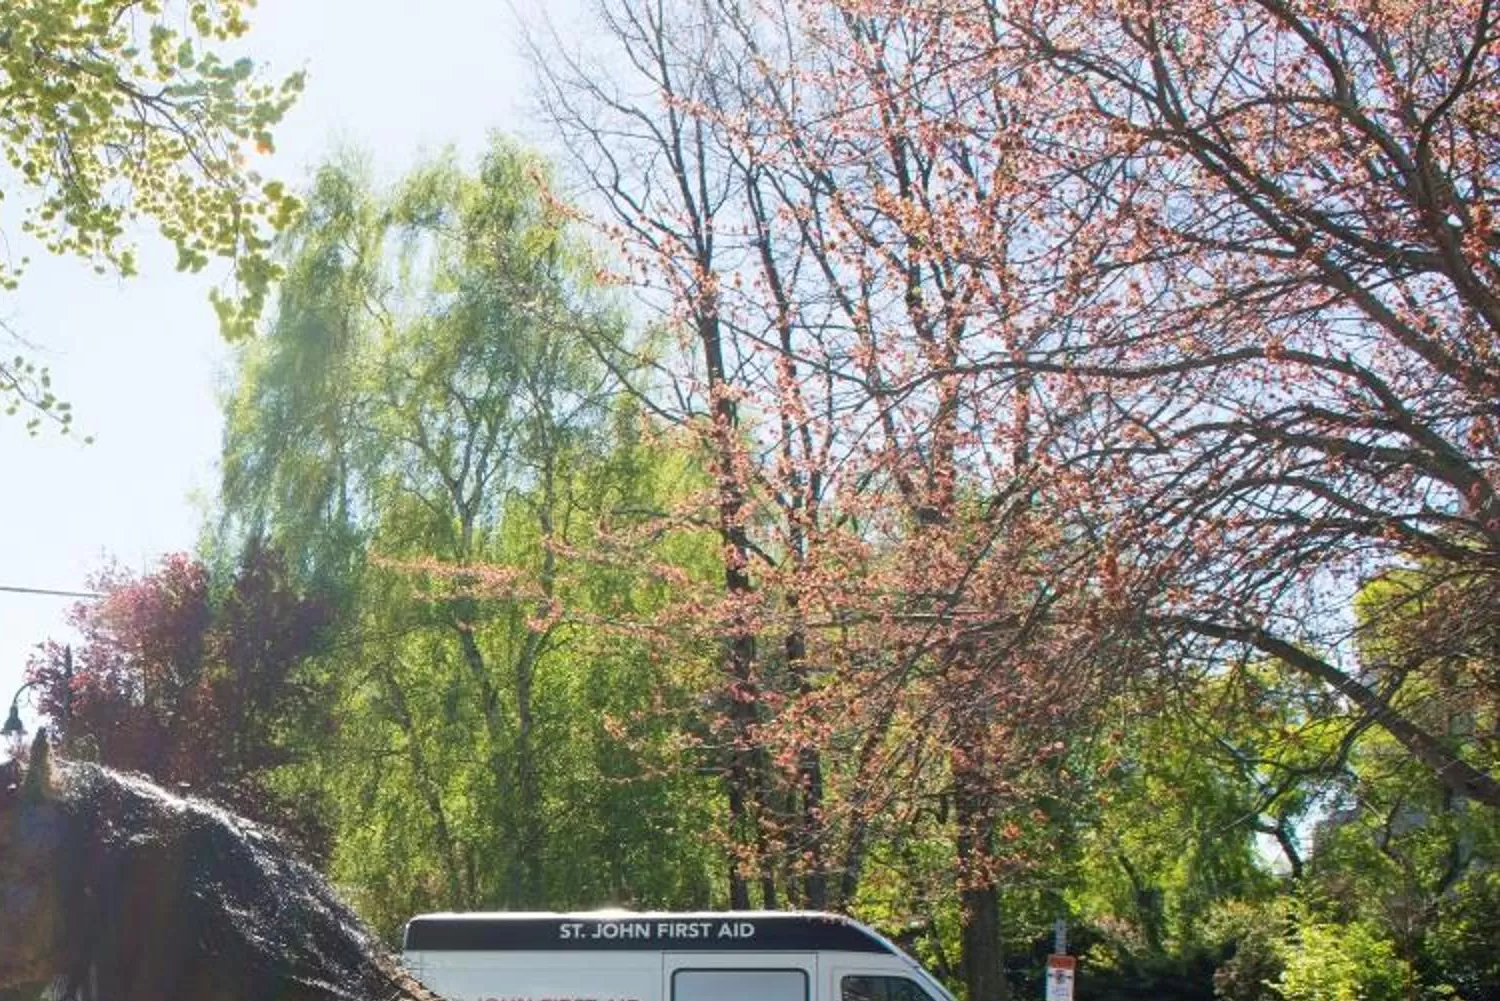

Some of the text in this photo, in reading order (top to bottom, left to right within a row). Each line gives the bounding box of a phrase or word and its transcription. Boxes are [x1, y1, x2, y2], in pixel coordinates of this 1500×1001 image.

[559, 922, 756, 939] ST. JOHN FIRST AID
